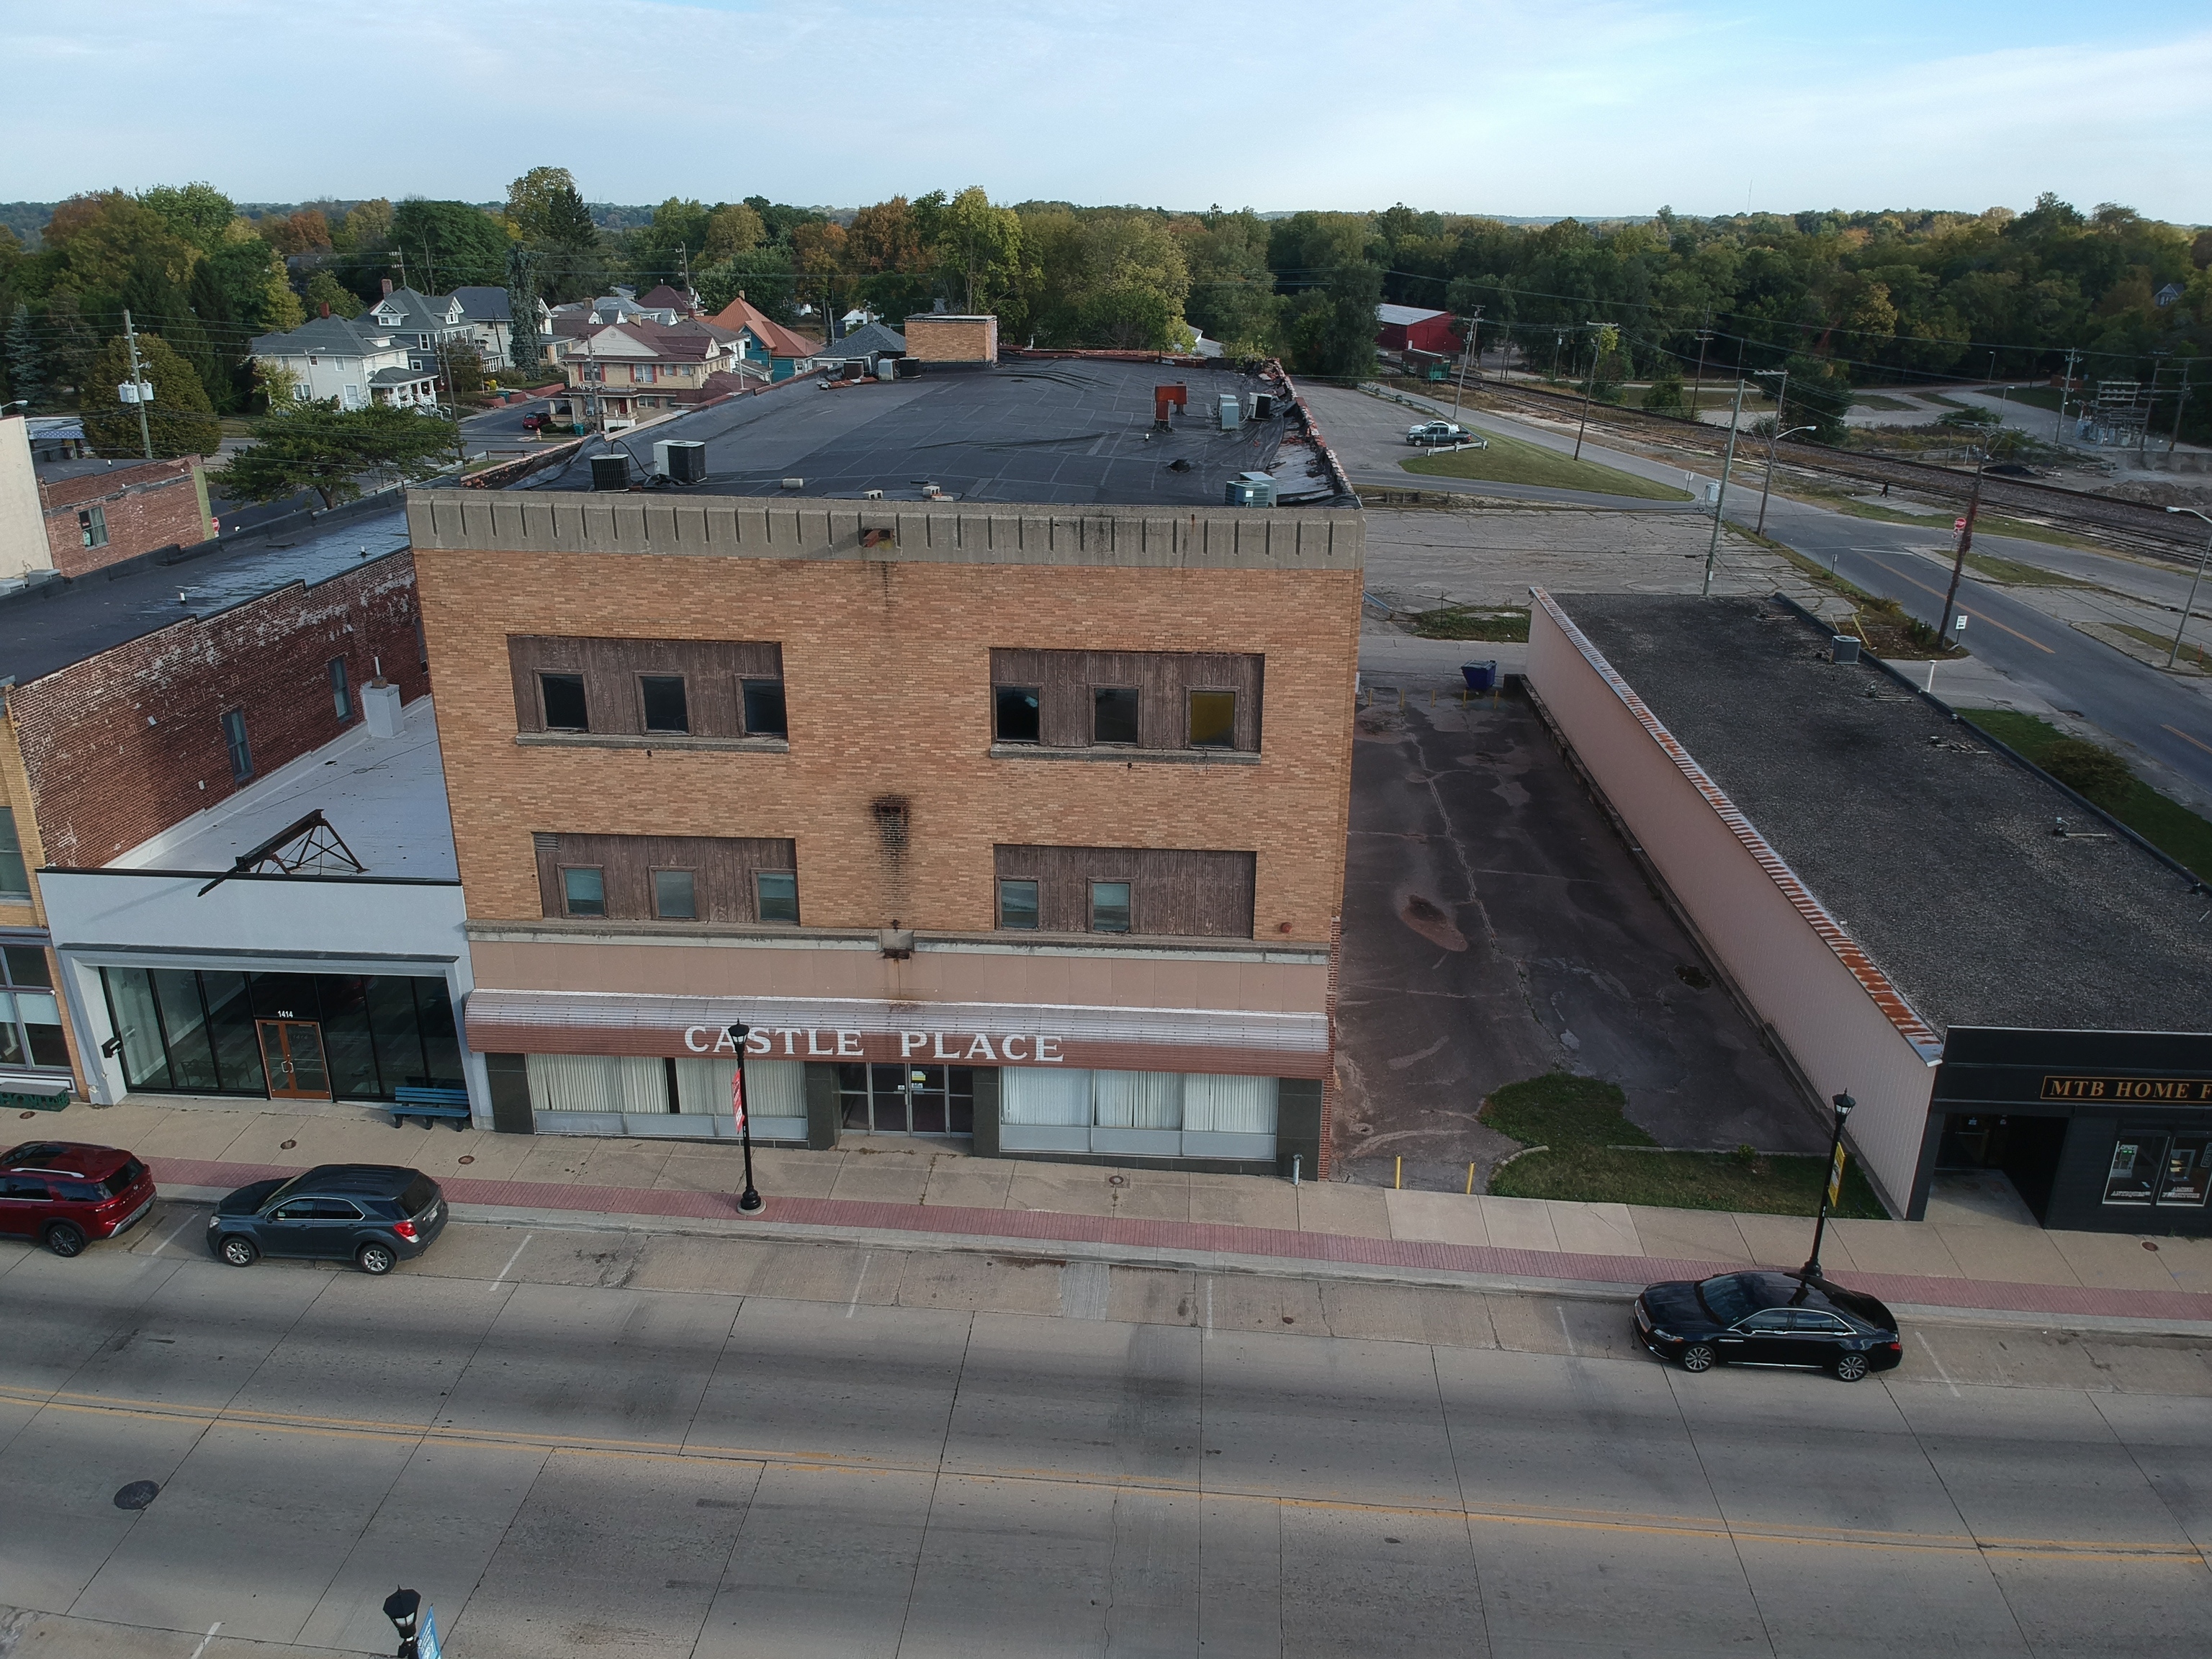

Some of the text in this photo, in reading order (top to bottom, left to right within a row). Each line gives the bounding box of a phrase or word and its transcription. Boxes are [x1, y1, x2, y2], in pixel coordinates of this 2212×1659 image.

[685, 1025, 1064, 1062] CASTLE PLACE
[2049, 1081, 2104, 1097] MTB
[2115, 1082, 2190, 1099] HOME
